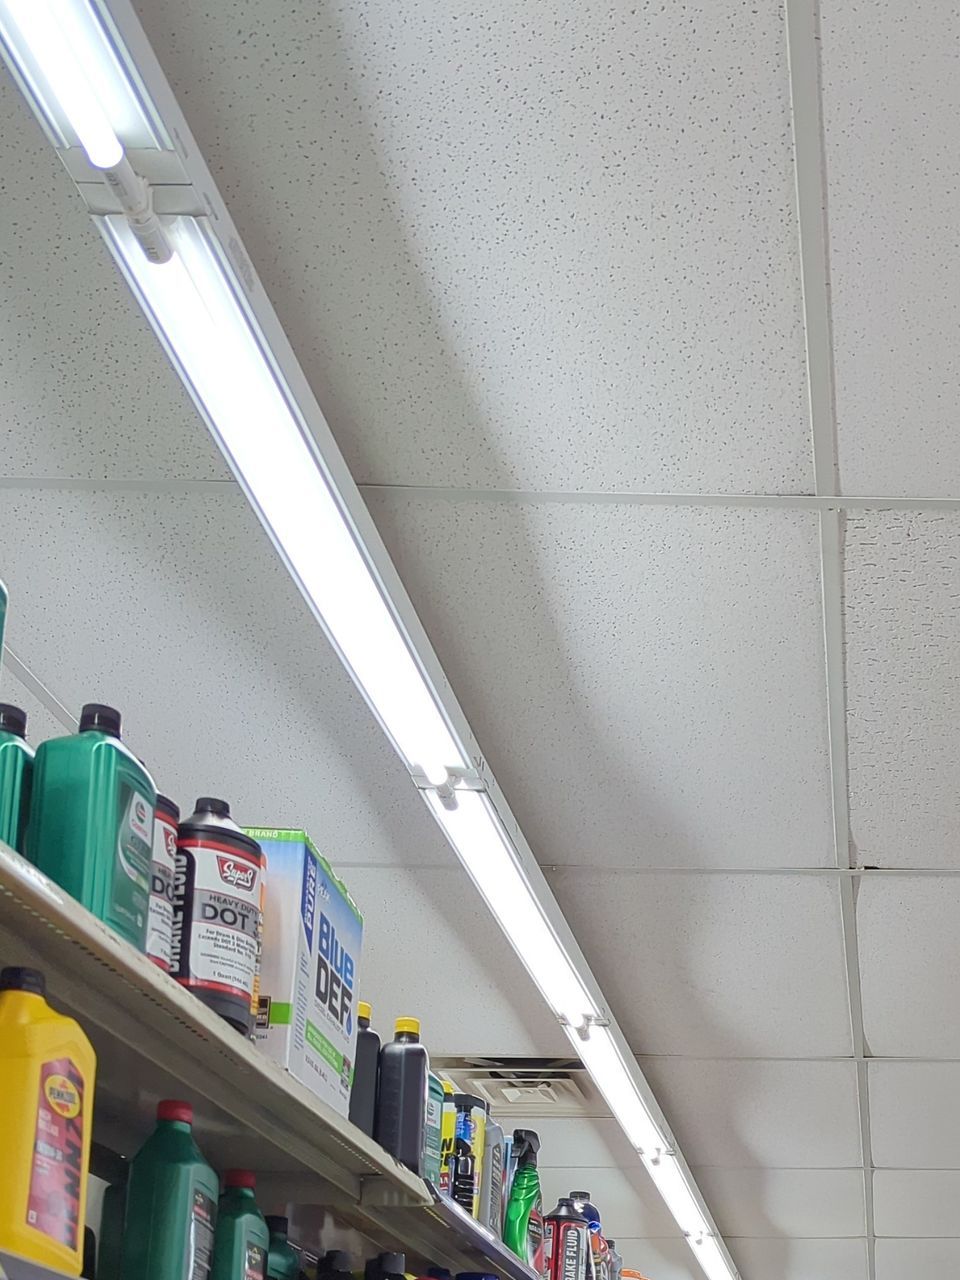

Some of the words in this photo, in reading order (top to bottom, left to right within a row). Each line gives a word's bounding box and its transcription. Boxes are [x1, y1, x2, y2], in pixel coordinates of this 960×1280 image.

[209, 894, 240, 910] HEAVY
[202, 903, 250, 931] DOT
[319, 911, 354, 988] Blue
[315, 952, 353, 1026] DEF
[566, 1229, 578, 1257] FLUID
